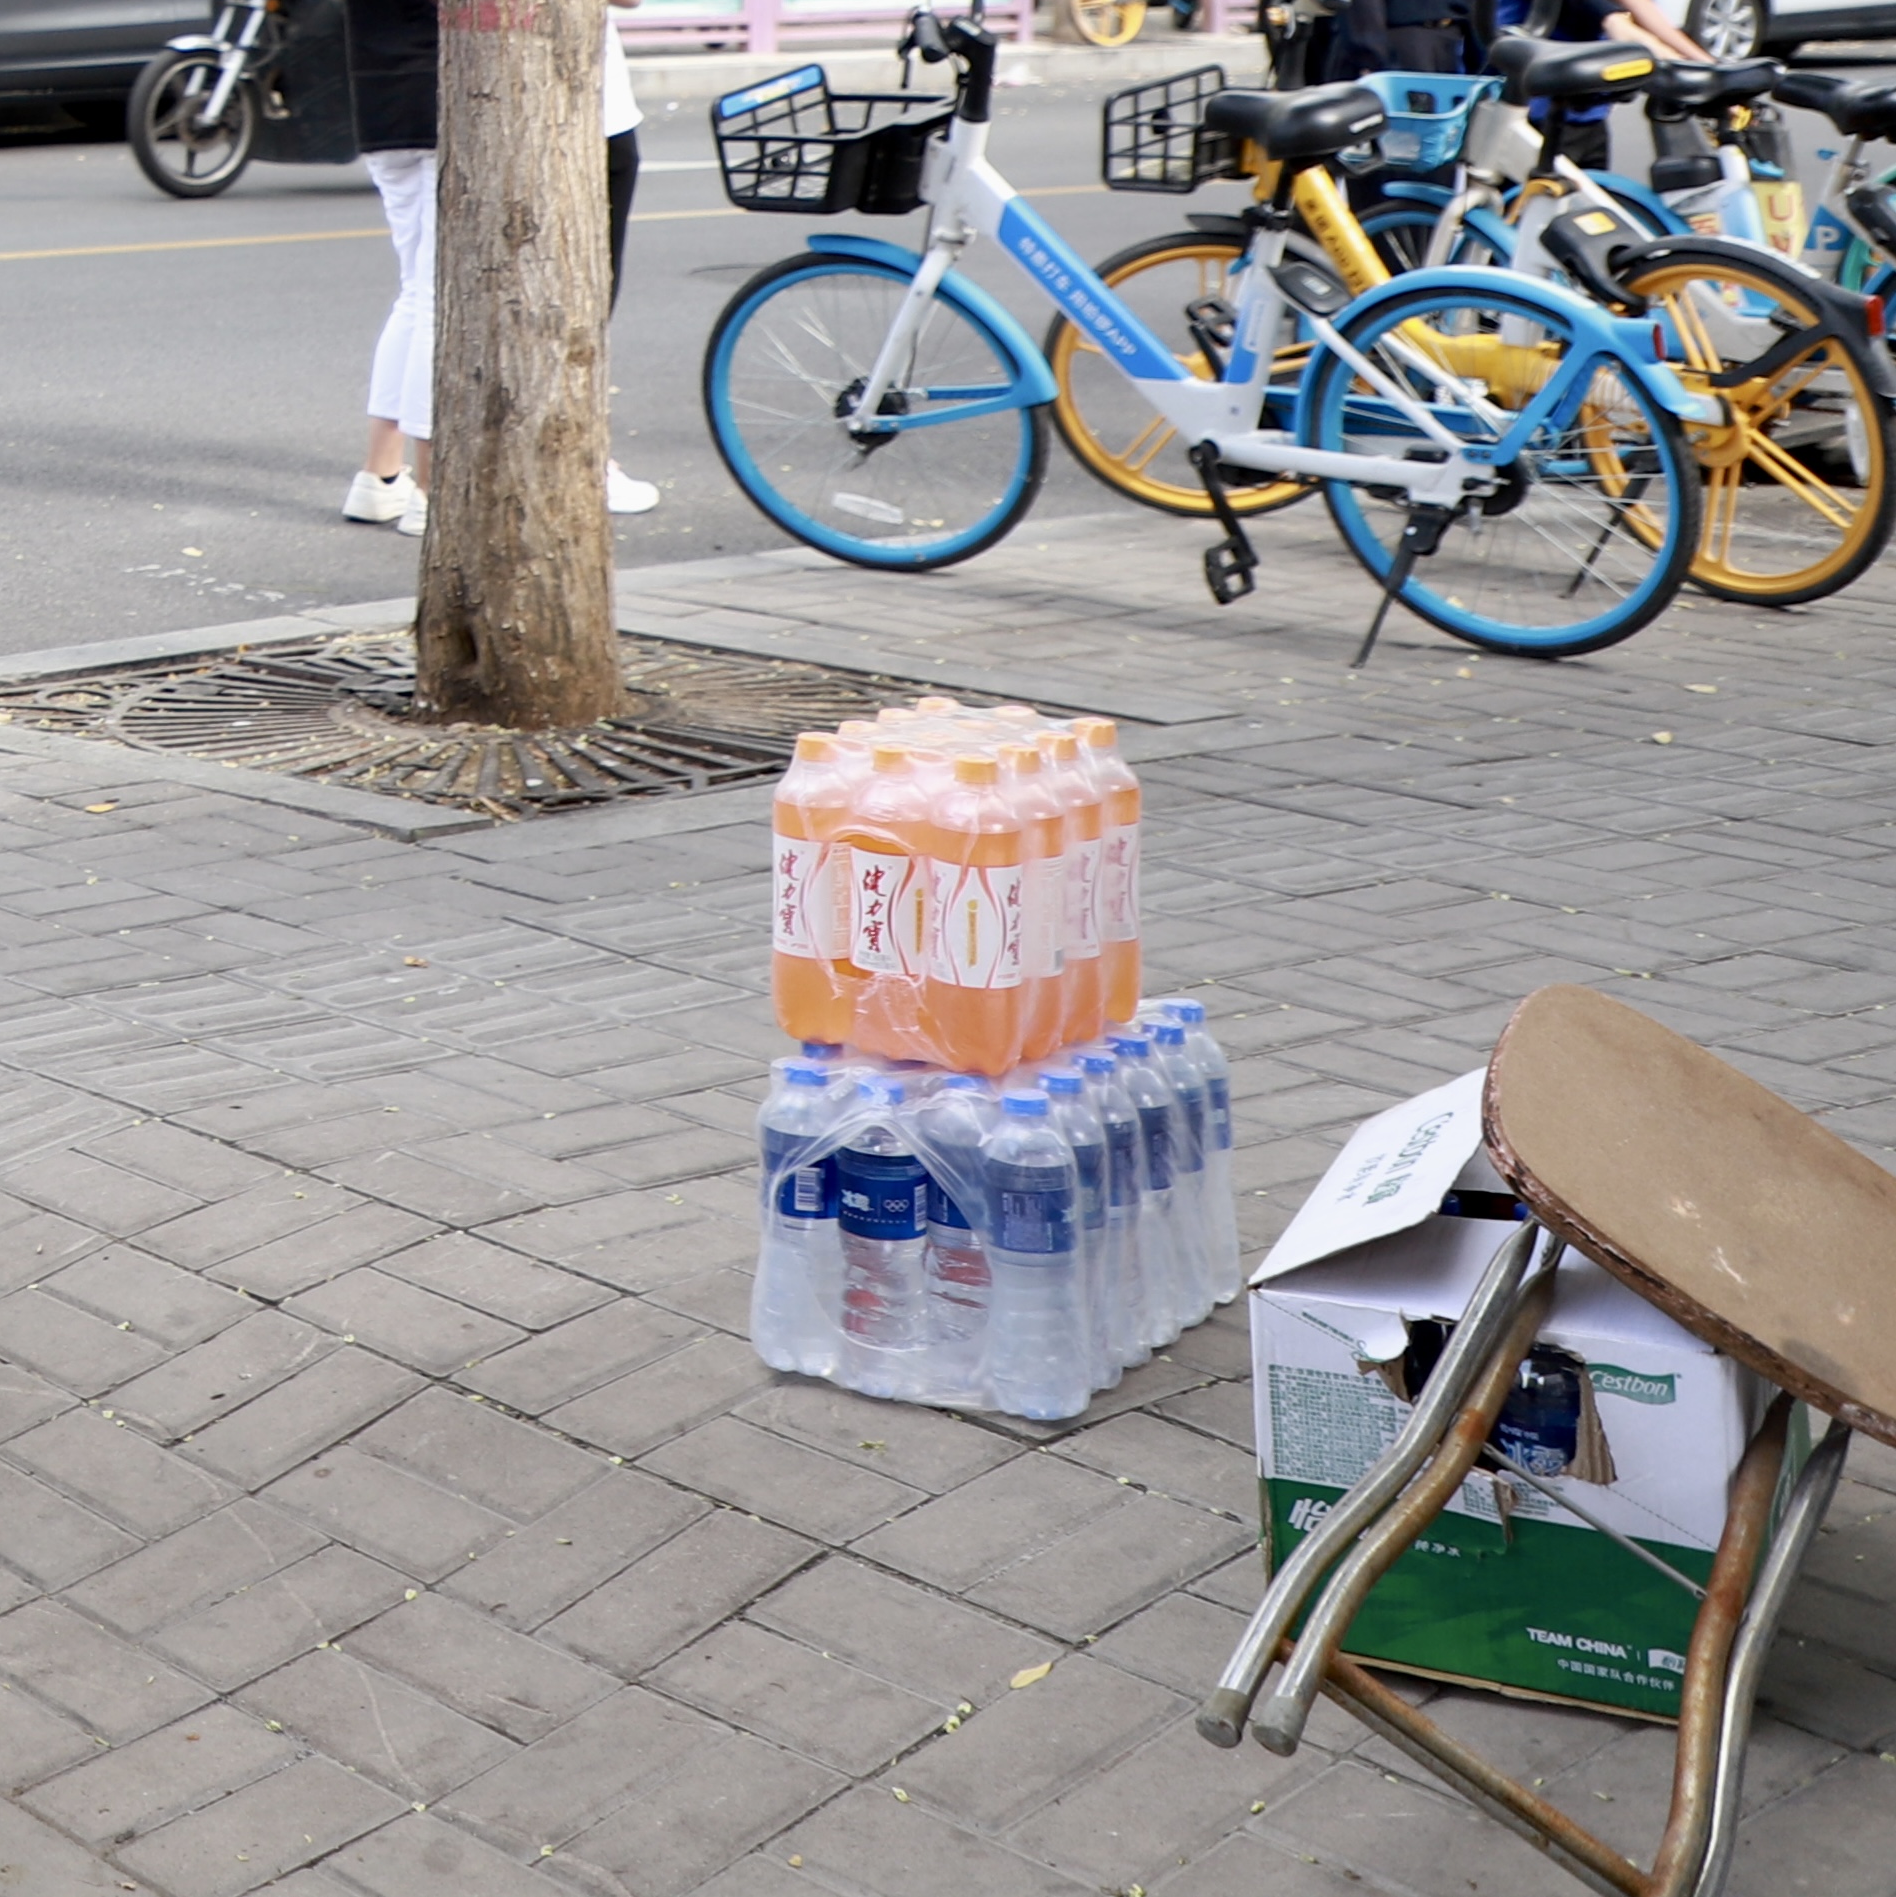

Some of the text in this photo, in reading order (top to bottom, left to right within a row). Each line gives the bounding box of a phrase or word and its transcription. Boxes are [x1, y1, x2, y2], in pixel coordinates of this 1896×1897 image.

[1288, 1497, 1334, 1534] 怡
[1526, 1627, 1627, 1659] TEAM CHINA
[1557, 1658, 1675, 1691] 中国国家队合作伙伴
